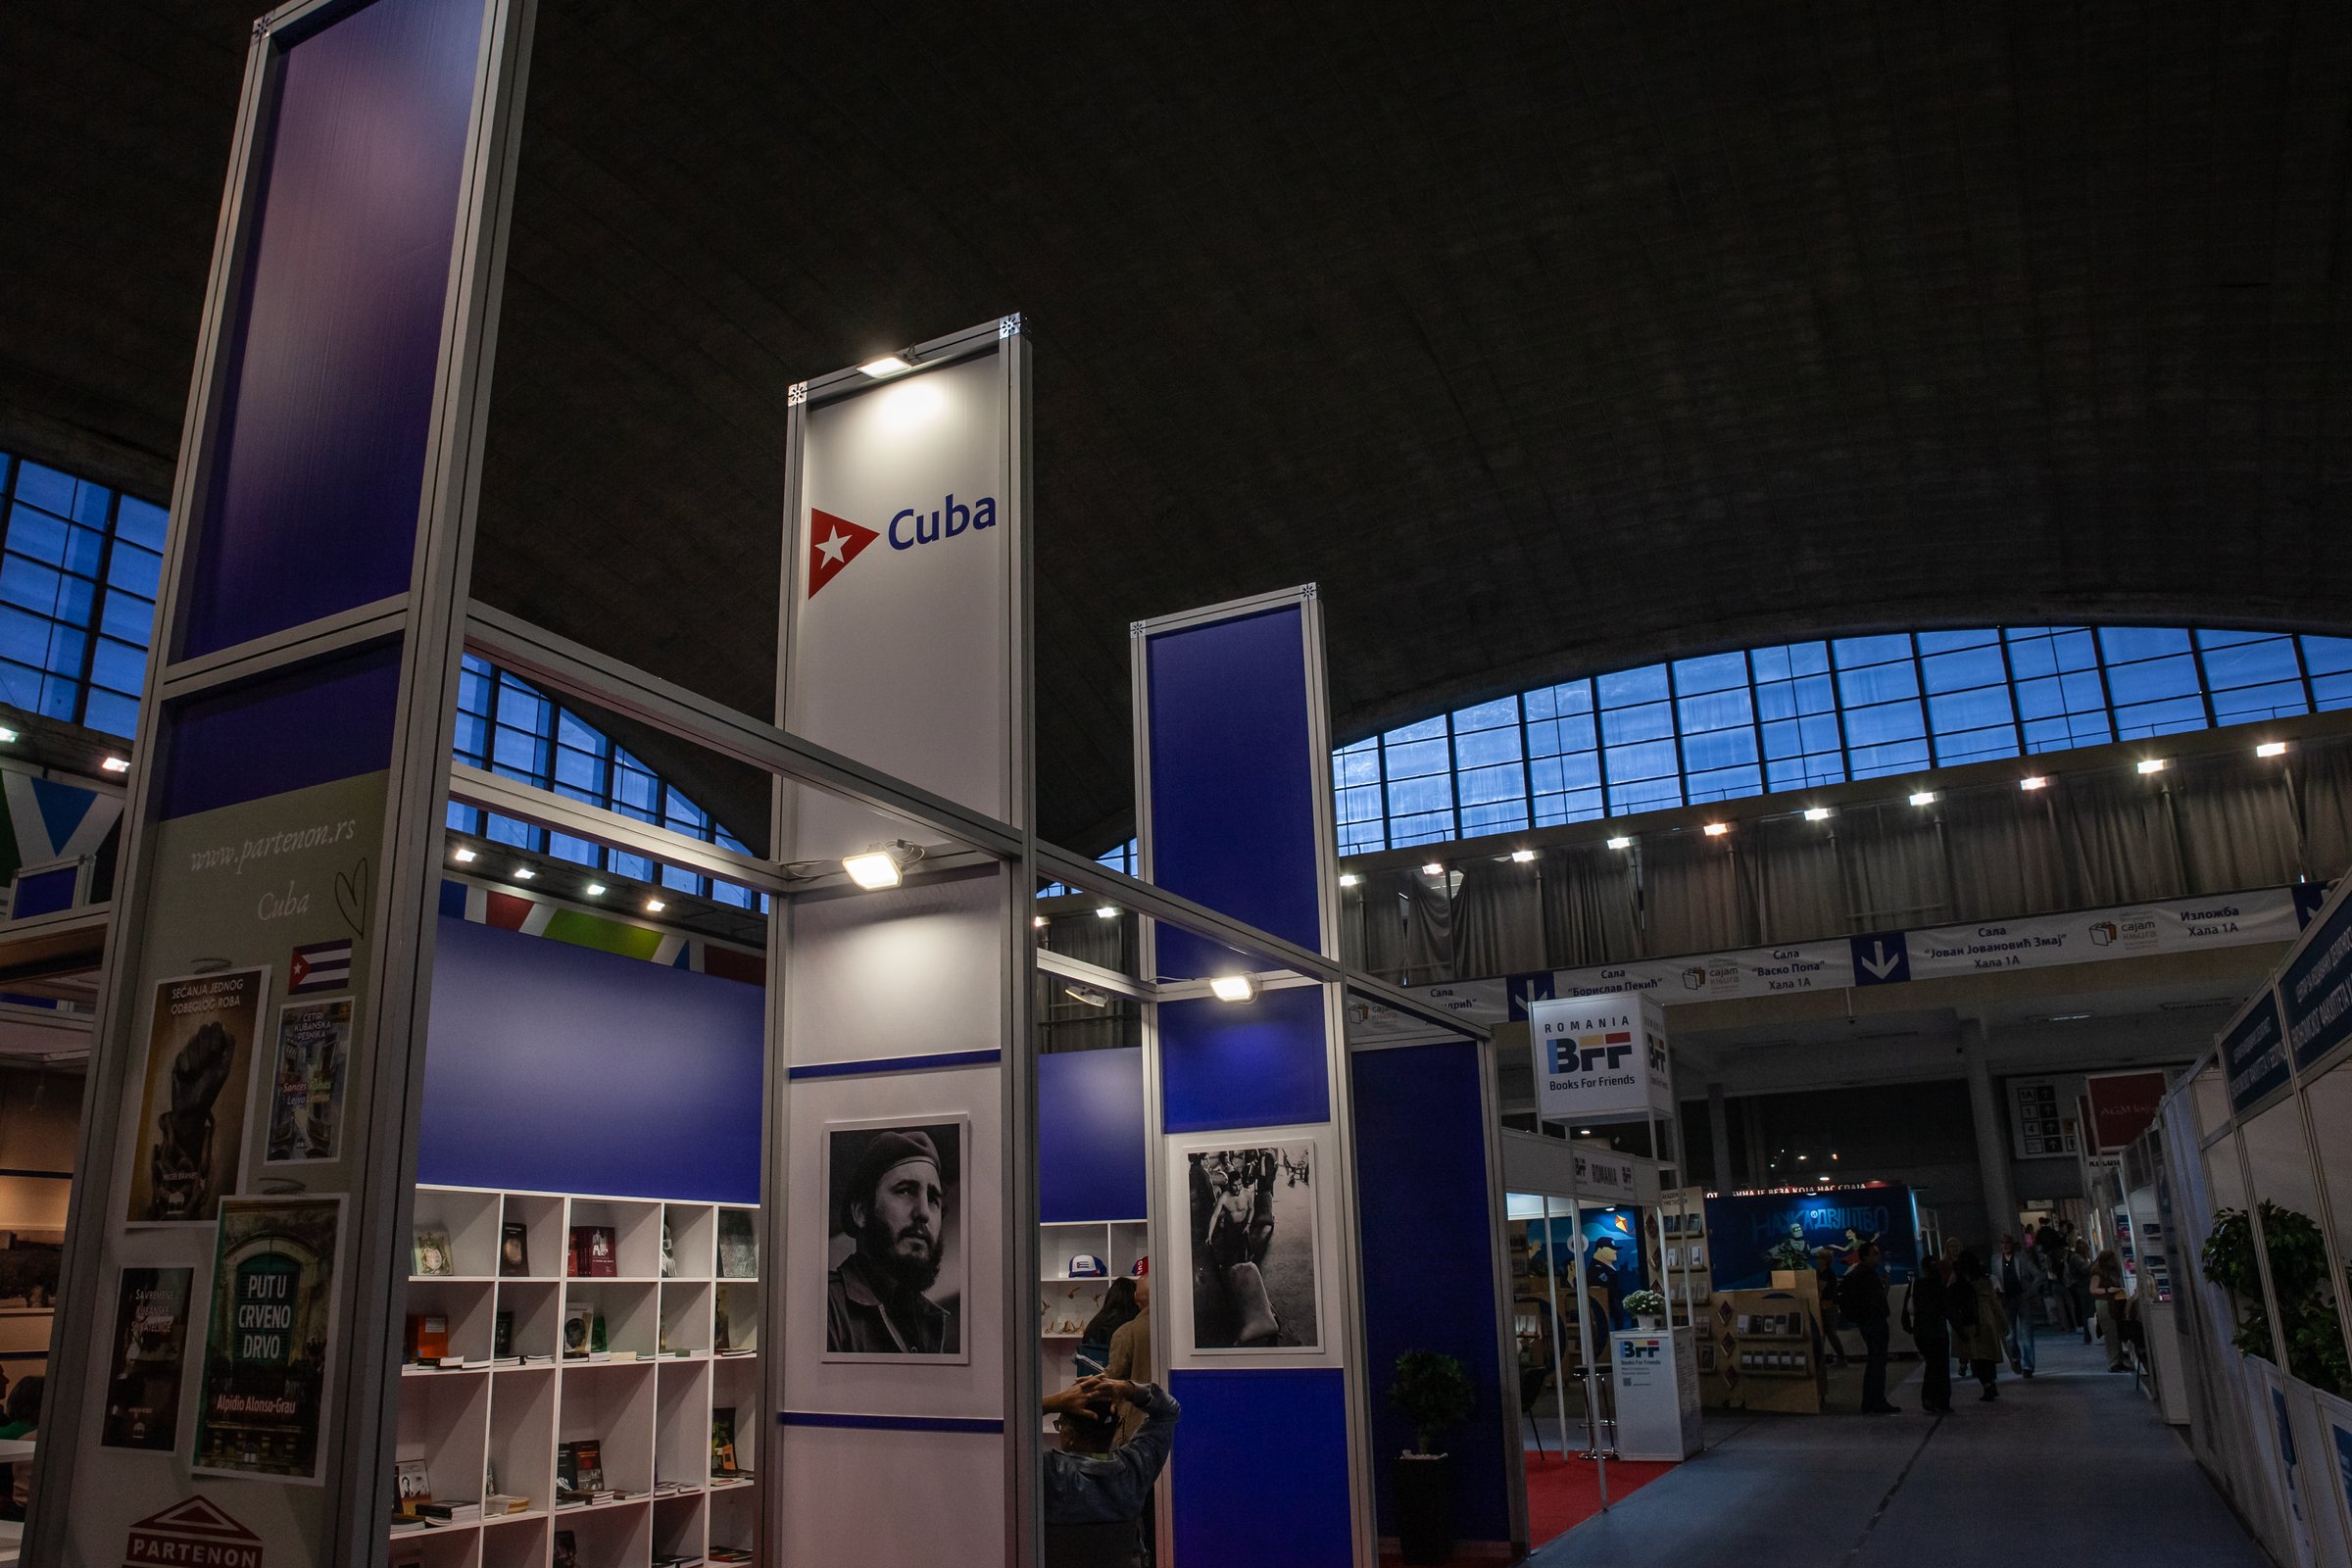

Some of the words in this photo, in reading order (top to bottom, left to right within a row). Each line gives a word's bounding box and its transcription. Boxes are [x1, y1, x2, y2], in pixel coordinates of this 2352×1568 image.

[888, 493, 997, 551] Cuba
[191, 819, 356, 874] www.partenon.rs
[258, 880, 311, 920] Cuba
[2180, 906, 2239, 922] Изложба
[1978, 927, 2007, 938] Сала
[2188, 925, 2219, 937] Хала
[1773, 950, 1799, 960] Сала
[1967, 938, 2032, 955] Јовановић
[1974, 958, 2003, 969] Хала
[1600, 969, 1626, 979] Сала
[209, 978, 244, 994] JEDNOG
[1430, 988, 1453, 998] Сала
[1768, 980, 1794, 990] Хала
[171, 998, 216, 1015] ODBEGLOG
[218, 995, 241, 1009] ROBA
[1544, 1015, 1630, 1034] ROMANIA
[1546, 1031, 1633, 1075] BFF
[1549, 1079, 1580, 1092] Books
[1581, 1077, 1597, 1089] For
[1598, 1074, 1636, 1088] Friends
[248, 1275, 277, 1299] PUT
[276, 1275, 287, 1299] U
[238, 1304, 291, 1329] CRVENO
[243, 1335, 280, 1359] DRVO
[217, 1394, 245, 1413] Alpidio
[245, 1395, 296, 1414] Alonso-Grau
[132, 1538, 257, 1568] PARTENON
